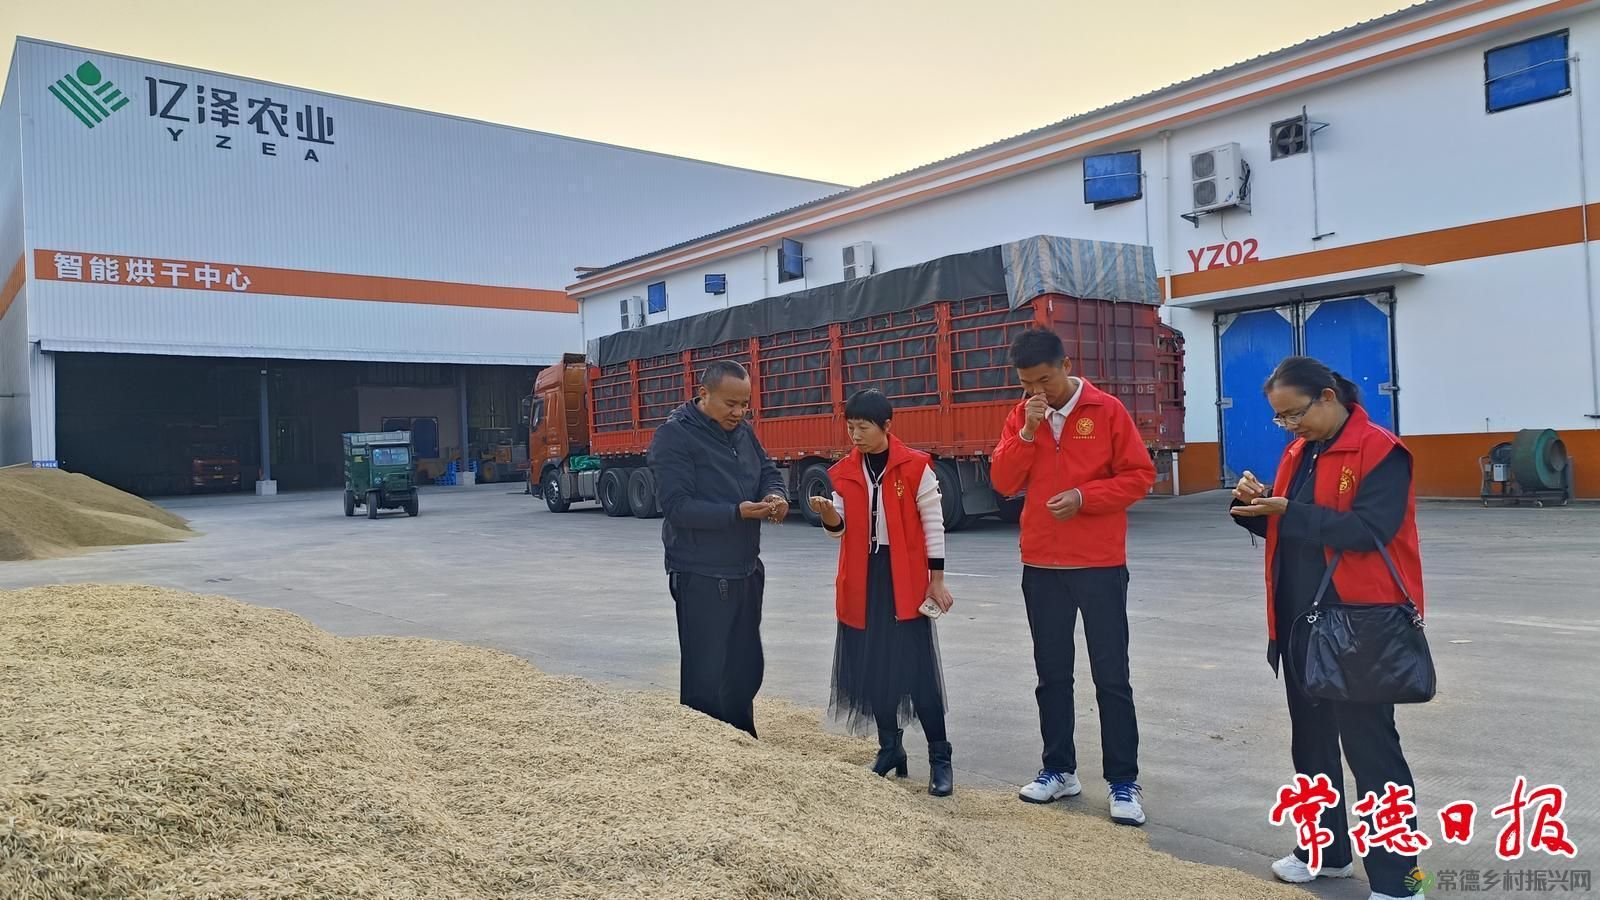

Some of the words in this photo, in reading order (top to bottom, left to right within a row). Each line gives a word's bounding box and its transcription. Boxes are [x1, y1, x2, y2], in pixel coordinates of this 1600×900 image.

[145, 76, 335, 145] 亿泽农业
[167, 127, 319, 162] YZEA
[53, 252, 251, 291] 智能烘干中心
[1187, 238, 1259, 272] YZ02
